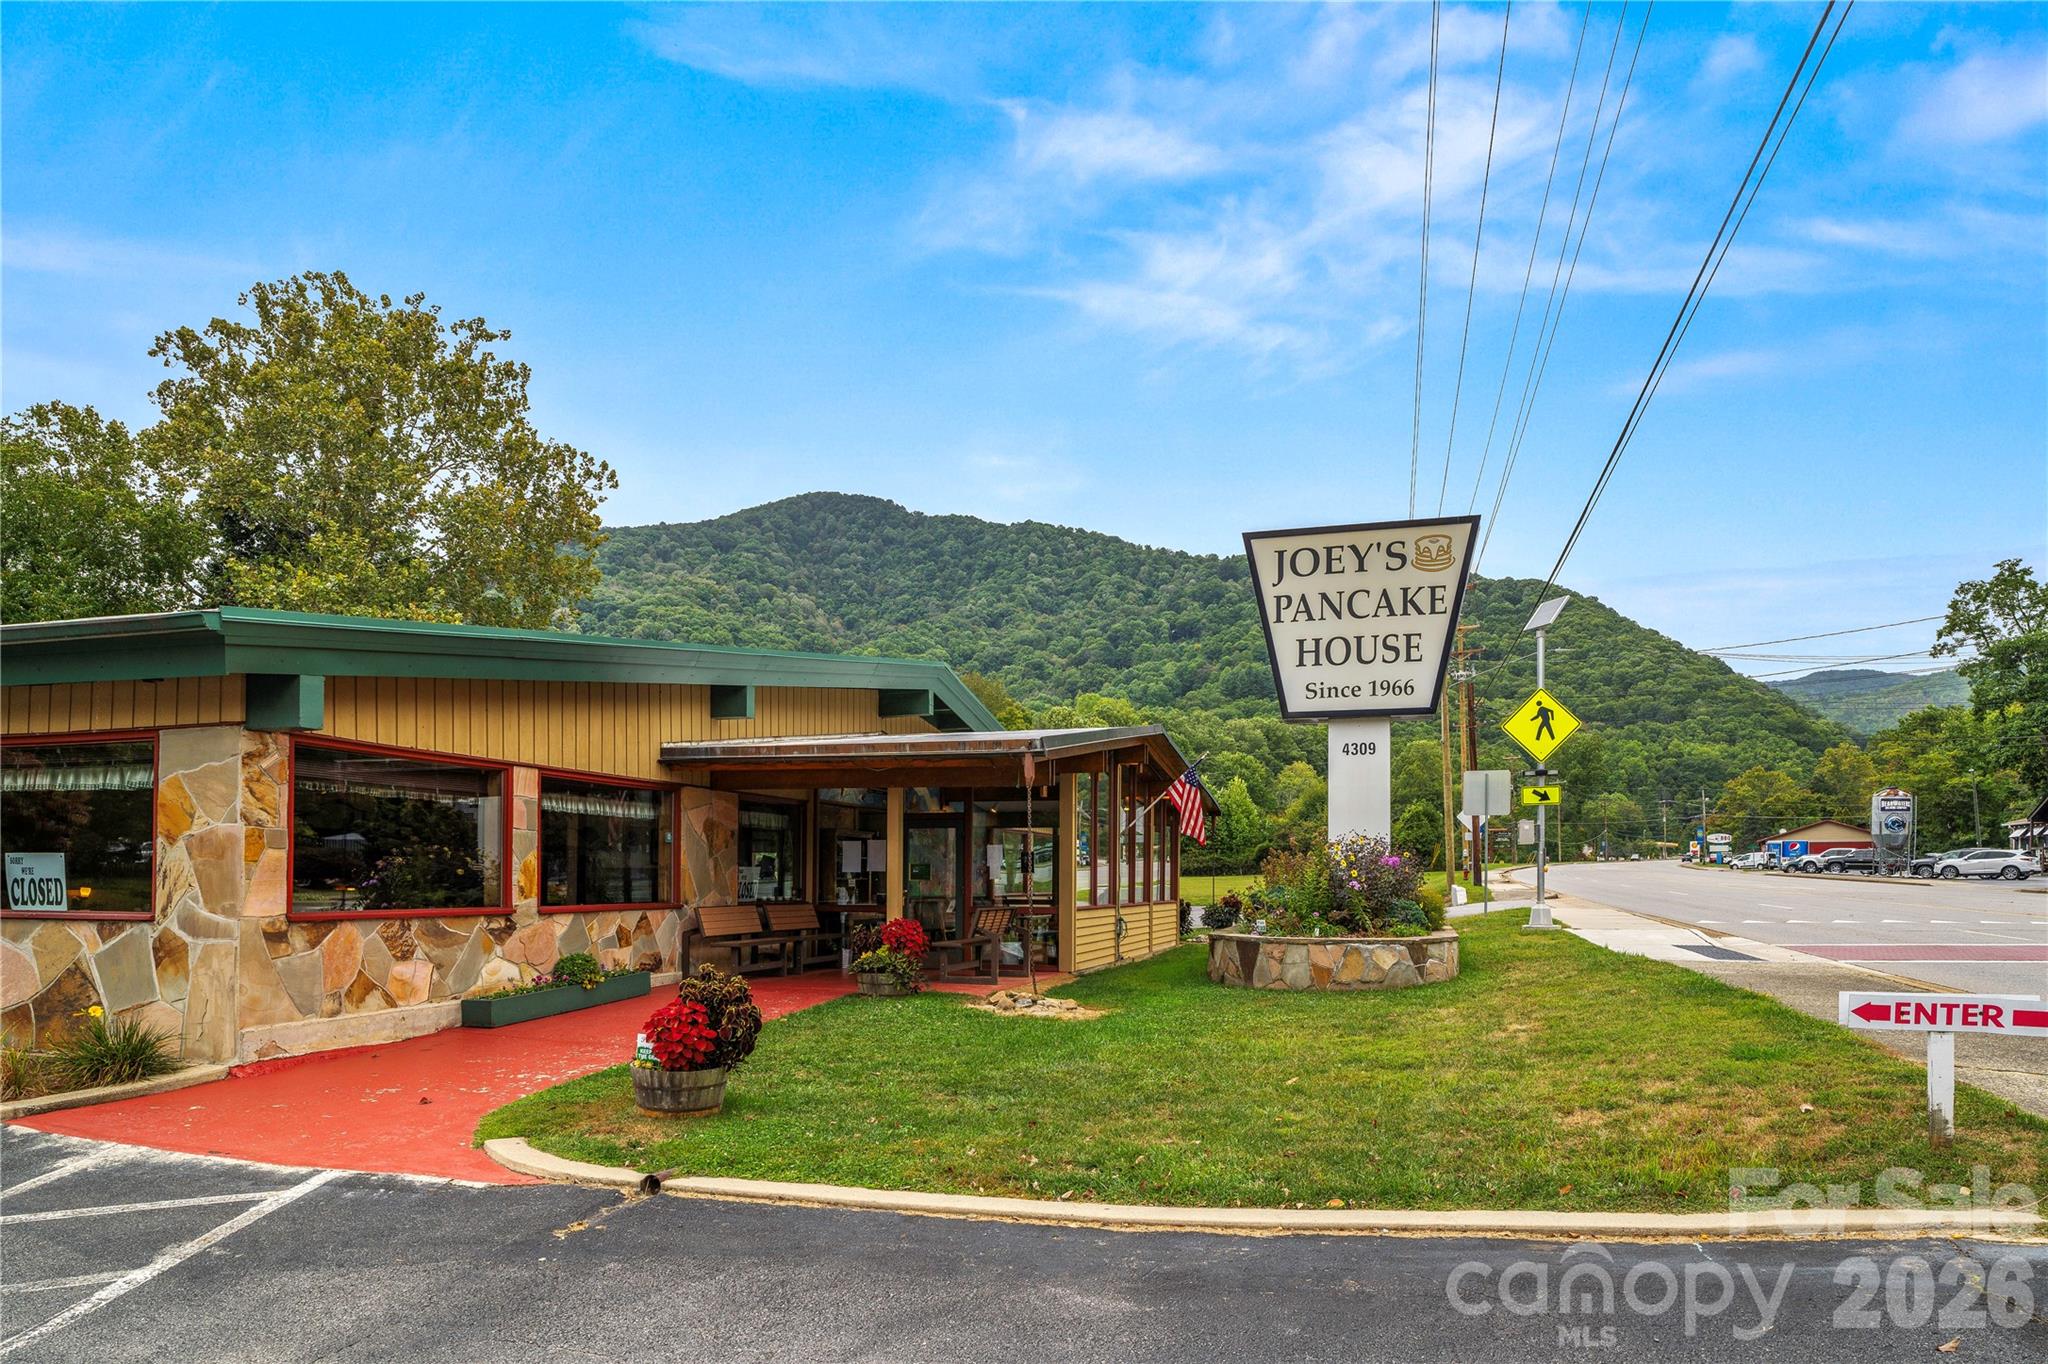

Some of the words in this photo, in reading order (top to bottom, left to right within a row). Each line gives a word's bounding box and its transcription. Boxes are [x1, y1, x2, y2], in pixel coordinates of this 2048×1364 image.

[1272, 541, 1408, 587] JOEY'S
[1272, 585, 1448, 624] PANCAKE
[1295, 632, 1423, 668] HOUSE
[1305, 681, 1362, 700] Since
[1368, 678, 1415, 697] 1966
[1342, 741, 1376, 756] 4309
[11, 877, 64, 907] CLOSED
[1894, 1002, 2005, 1028] ENTER
